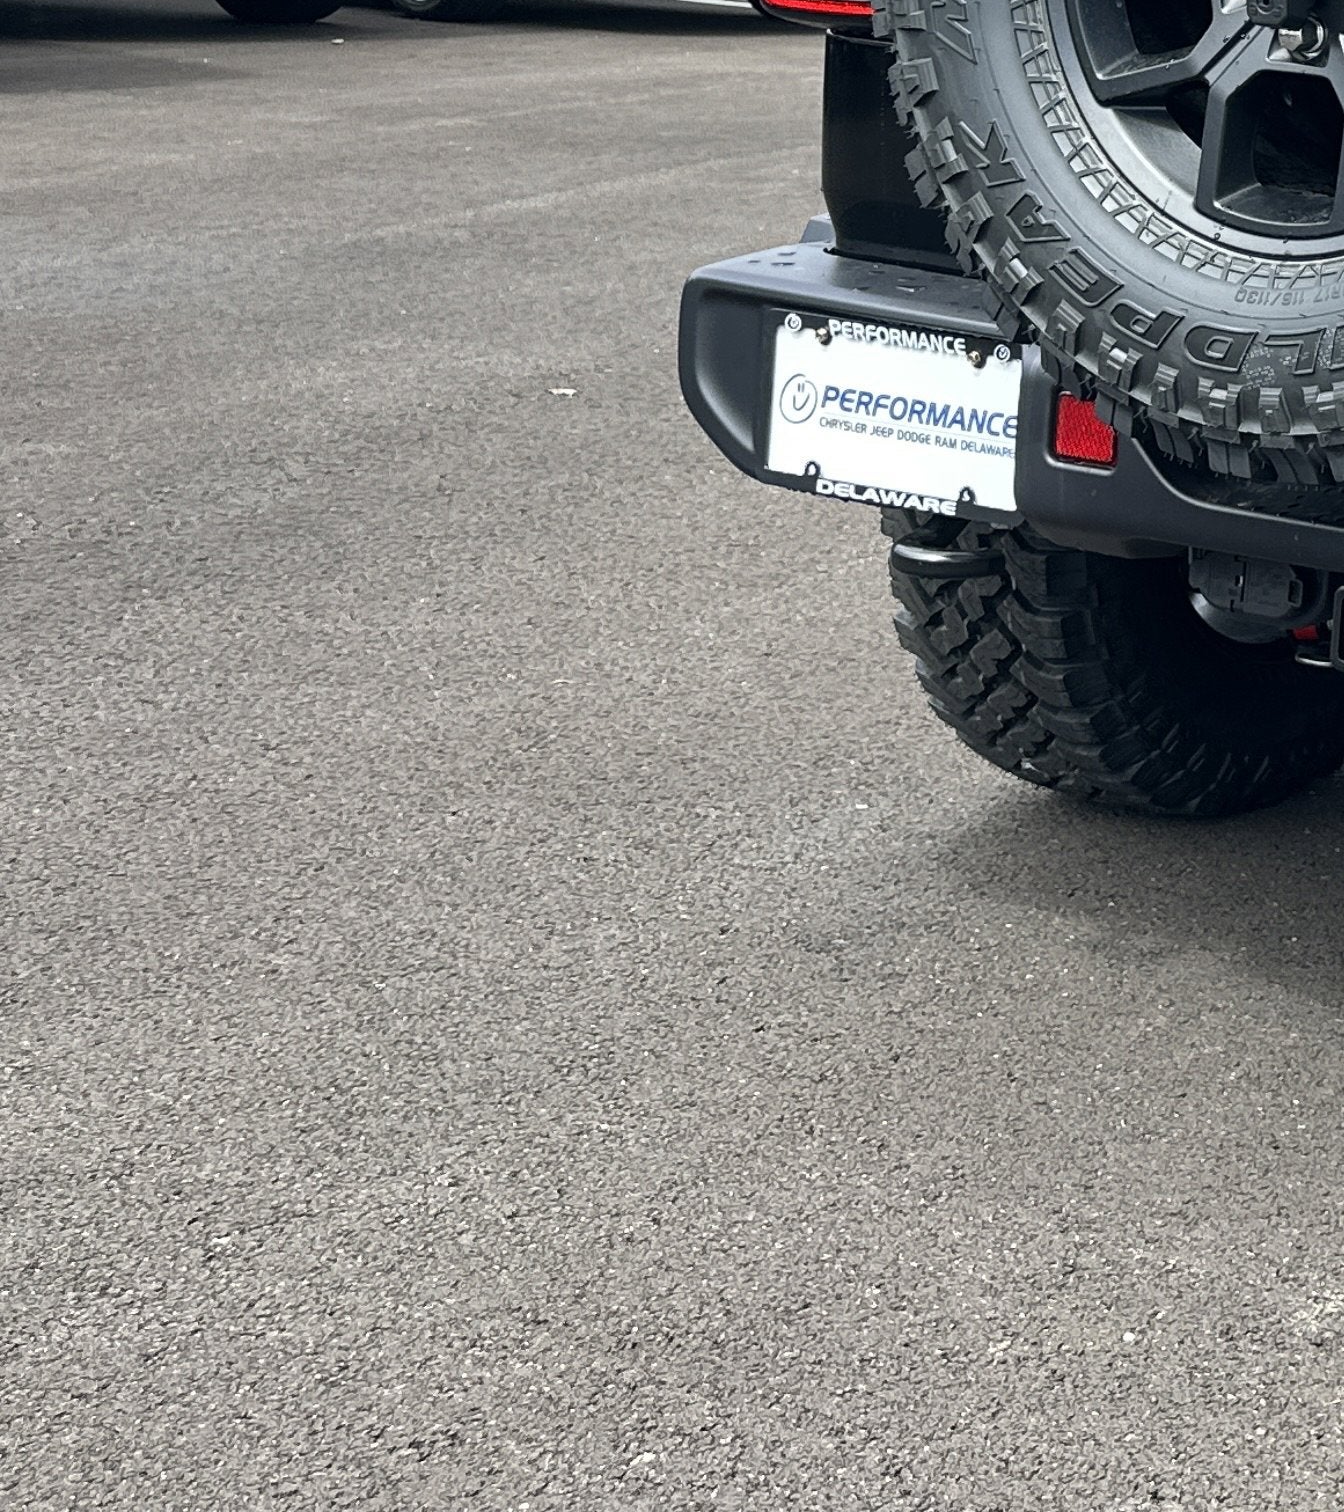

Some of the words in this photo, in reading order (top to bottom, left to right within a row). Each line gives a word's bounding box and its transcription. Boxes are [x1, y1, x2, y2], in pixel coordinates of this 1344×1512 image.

[828, 319, 967, 355] PERFORMANCE
[821, 385, 1018, 439] PERFORMANCE
[819, 416, 867, 435] CHRYSLER
[870, 425, 894, 439] JEEP
[897, 429, 932, 445] DODGE
[934, 435, 957, 449] RAM
[961, 439, 1016, 459] DELAWARE
[816, 477, 957, 516] DELAWARE
